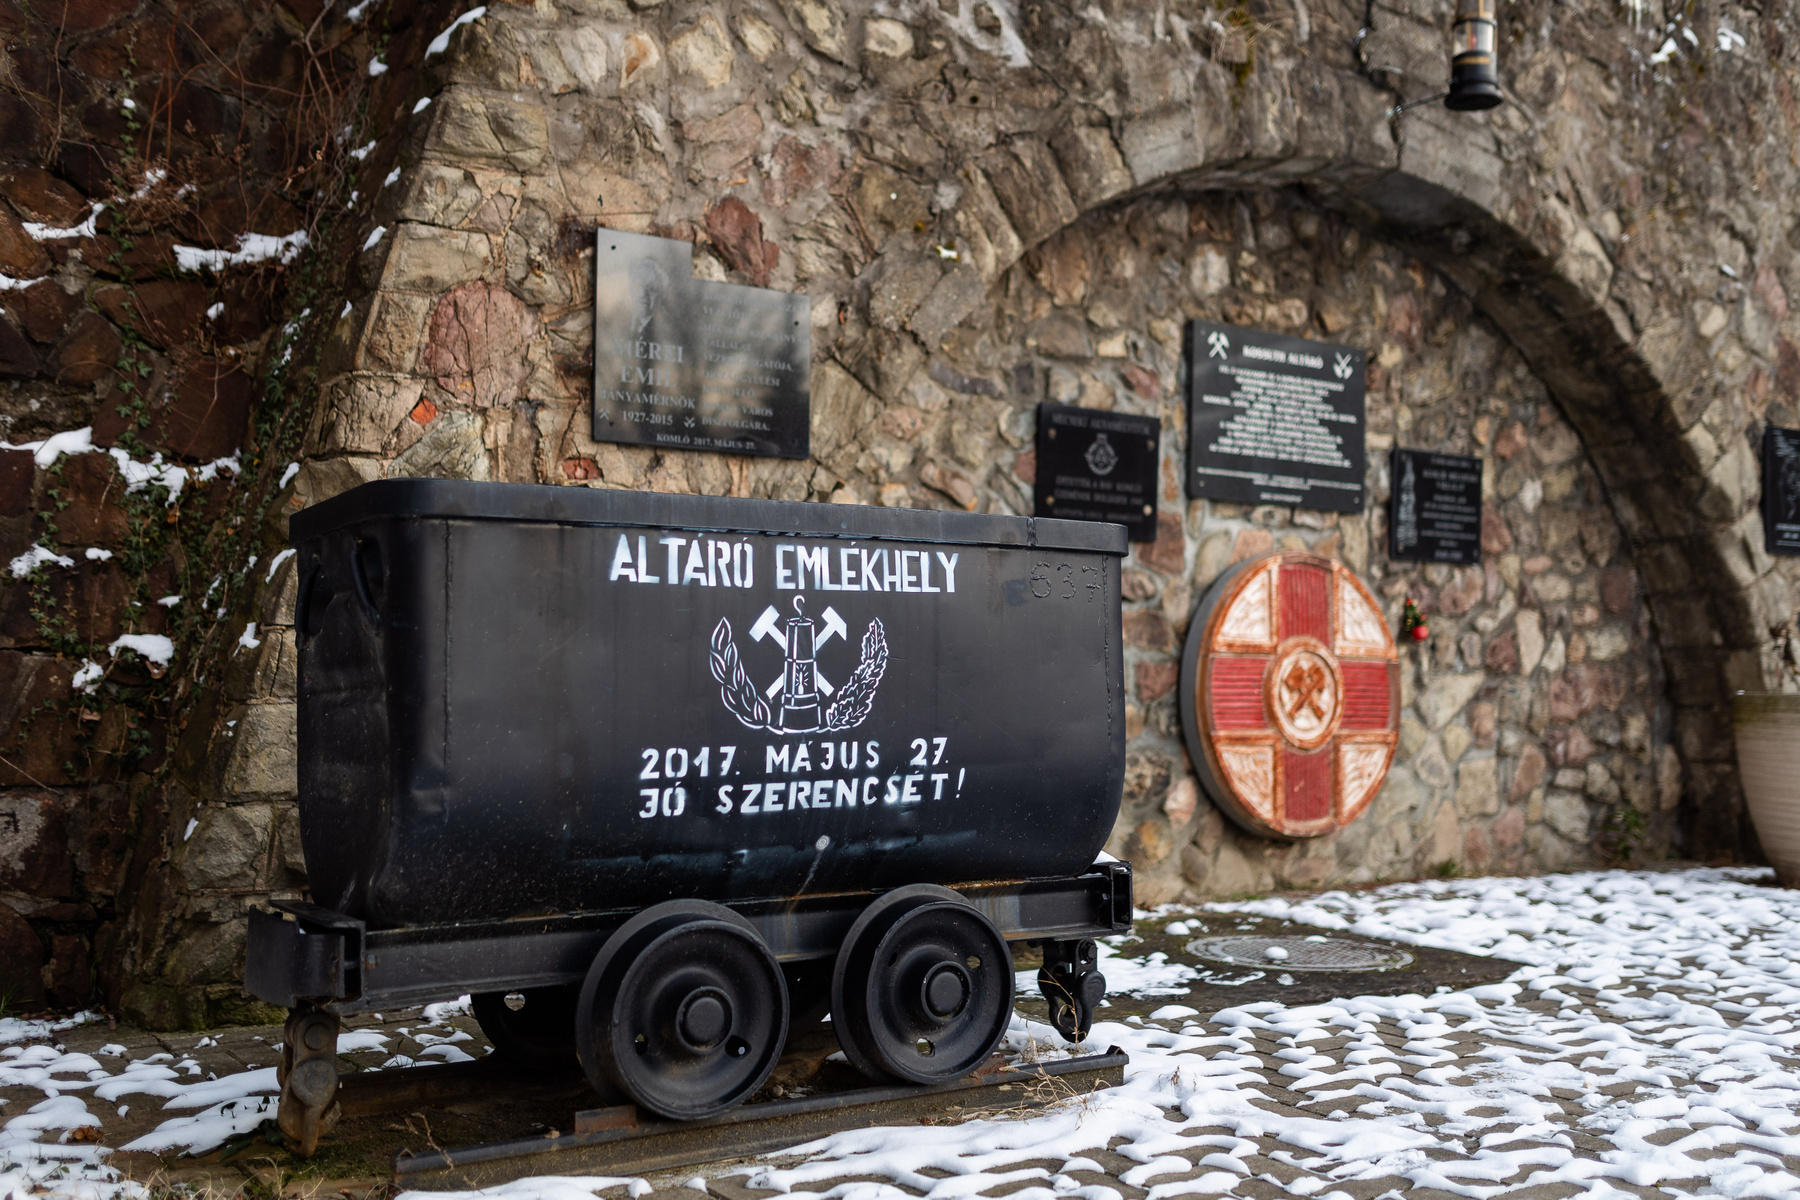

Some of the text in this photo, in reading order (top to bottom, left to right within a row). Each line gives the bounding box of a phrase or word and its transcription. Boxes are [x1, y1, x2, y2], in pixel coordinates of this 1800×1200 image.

[613, 336, 684, 363] MÉREI
[621, 366, 676, 388] EMIL
[622, 410, 674, 426] 1927-2015
[656, 433, 690, 445] KOMLÓ
[609, 532, 959, 594] ALTÁRÓ EMLÉKHELY
[1030, 561, 1101, 603] 637
[639, 736, 949, 779] 2017. MÁJUS 27.
[638, 781, 686, 819] JÓ
